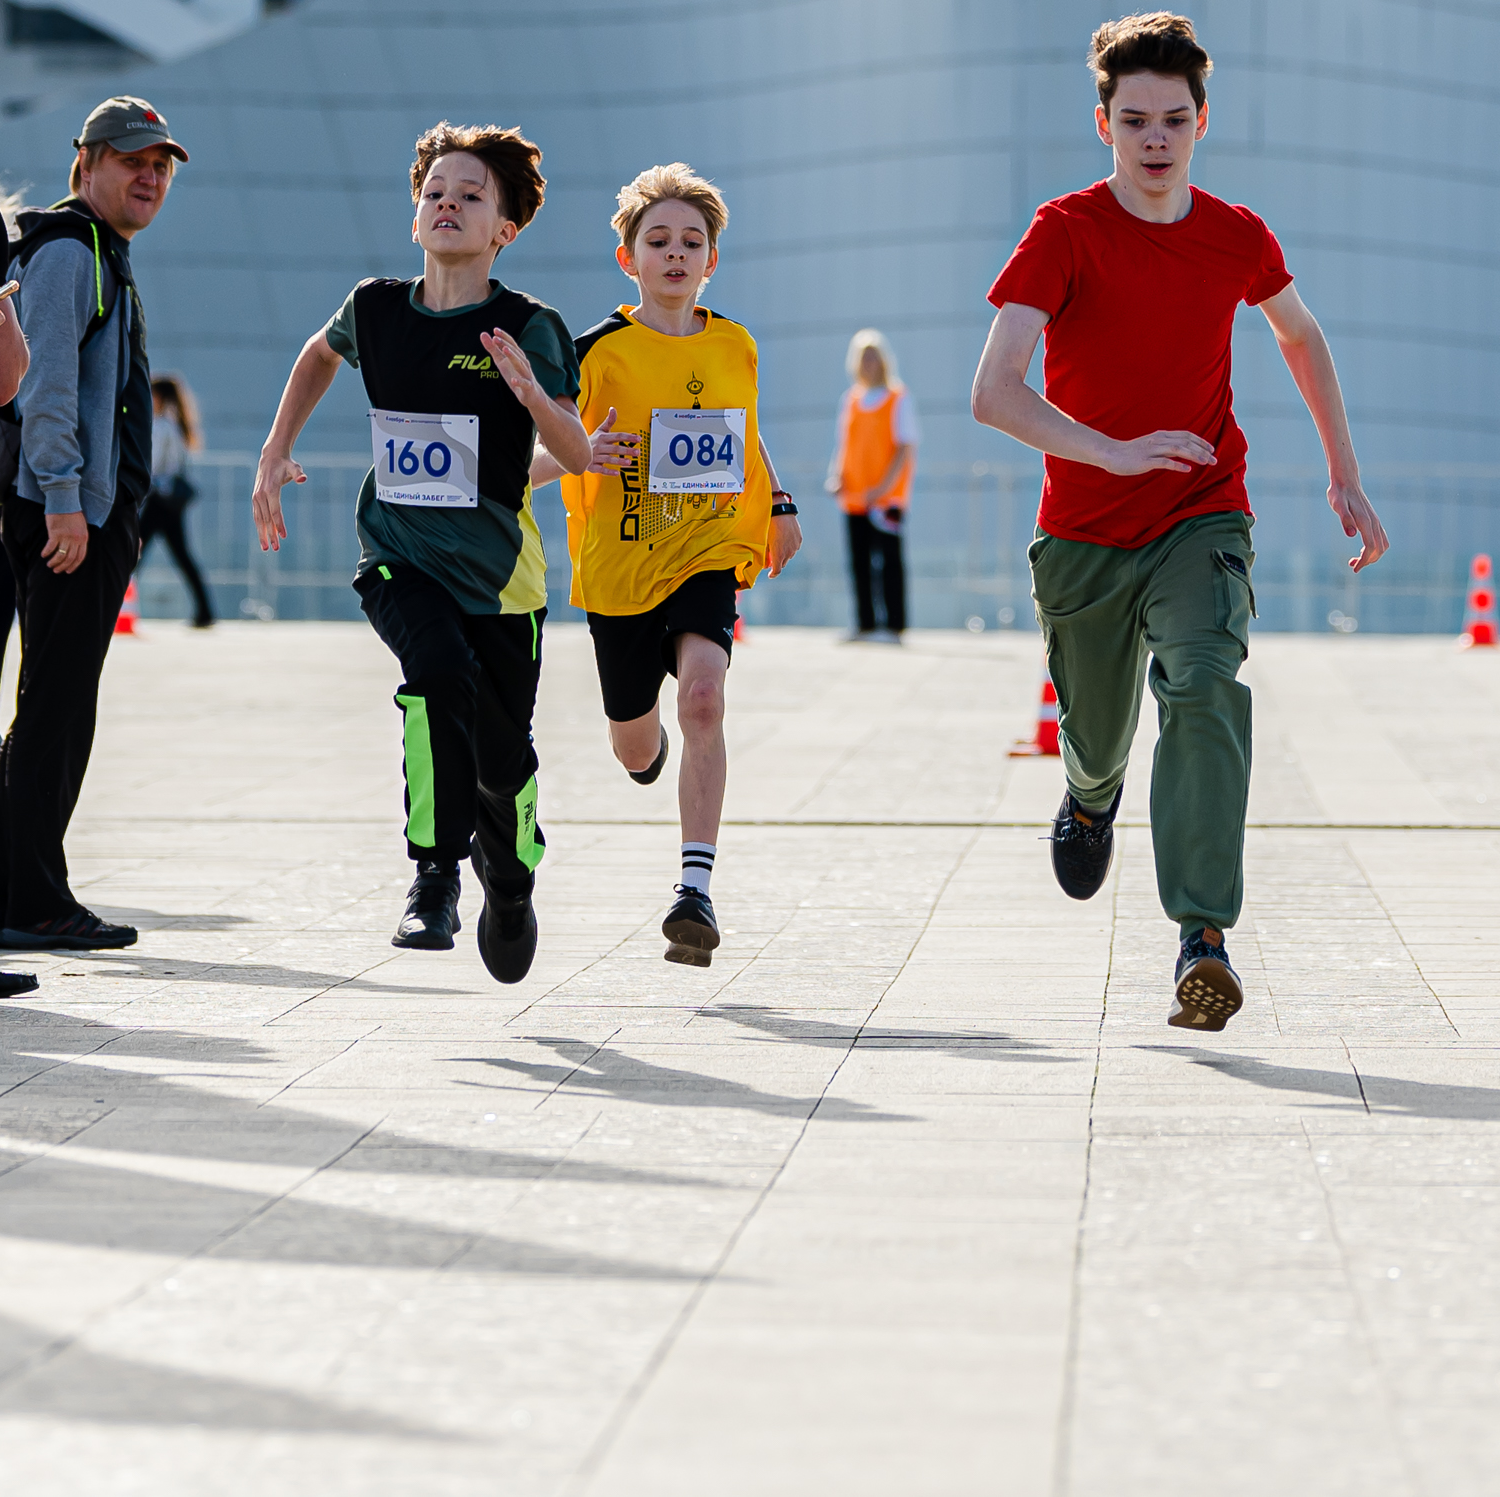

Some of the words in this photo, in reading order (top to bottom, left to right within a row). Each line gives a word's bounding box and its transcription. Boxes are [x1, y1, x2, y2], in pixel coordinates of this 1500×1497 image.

[448, 355, 491, 370] FILA
[480, 371, 499, 379] PRO
[669, 433, 734, 467] 084
[385, 439, 452, 478] 160
[682, 481, 709, 489] ЕДИНЫЙ
[393, 491, 421, 501] ЕДИНЫЙ
[422, 494, 445, 502] ЗАБЕГ
